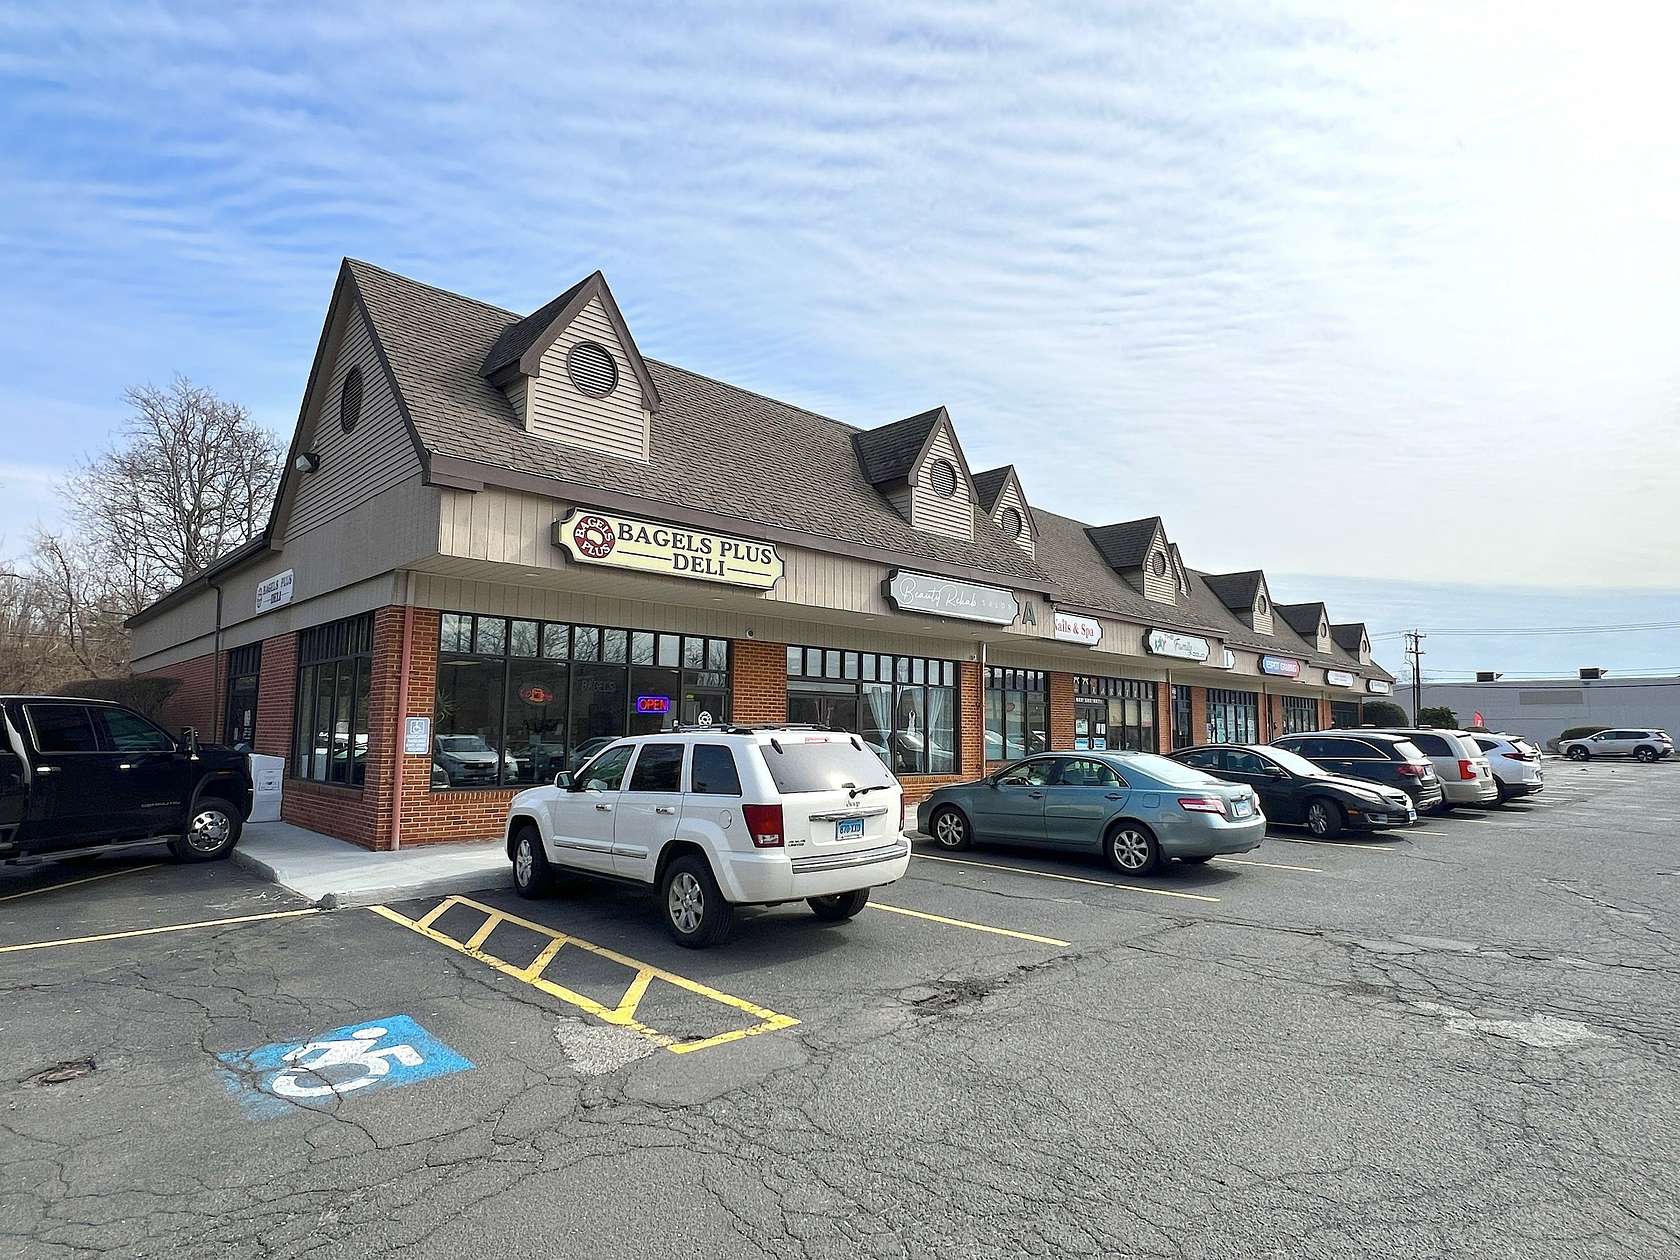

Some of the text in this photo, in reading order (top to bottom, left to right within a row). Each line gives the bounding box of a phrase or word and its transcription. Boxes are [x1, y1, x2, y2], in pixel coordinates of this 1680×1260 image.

[574, 517, 614, 542] BAGELS
[581, 540, 610, 557] PLUS
[617, 522, 772, 564] BAGELS PLUS
[672, 552, 725, 576] DELI
[901, 577, 941, 606] Beauty
[940, 584, 977, 608] Rehab
[1022, 601, 1036, 626] A
[1073, 622, 1079, 635] &
[1081, 624, 1094, 639] Spa
[640, 699, 667, 711] OPEN
